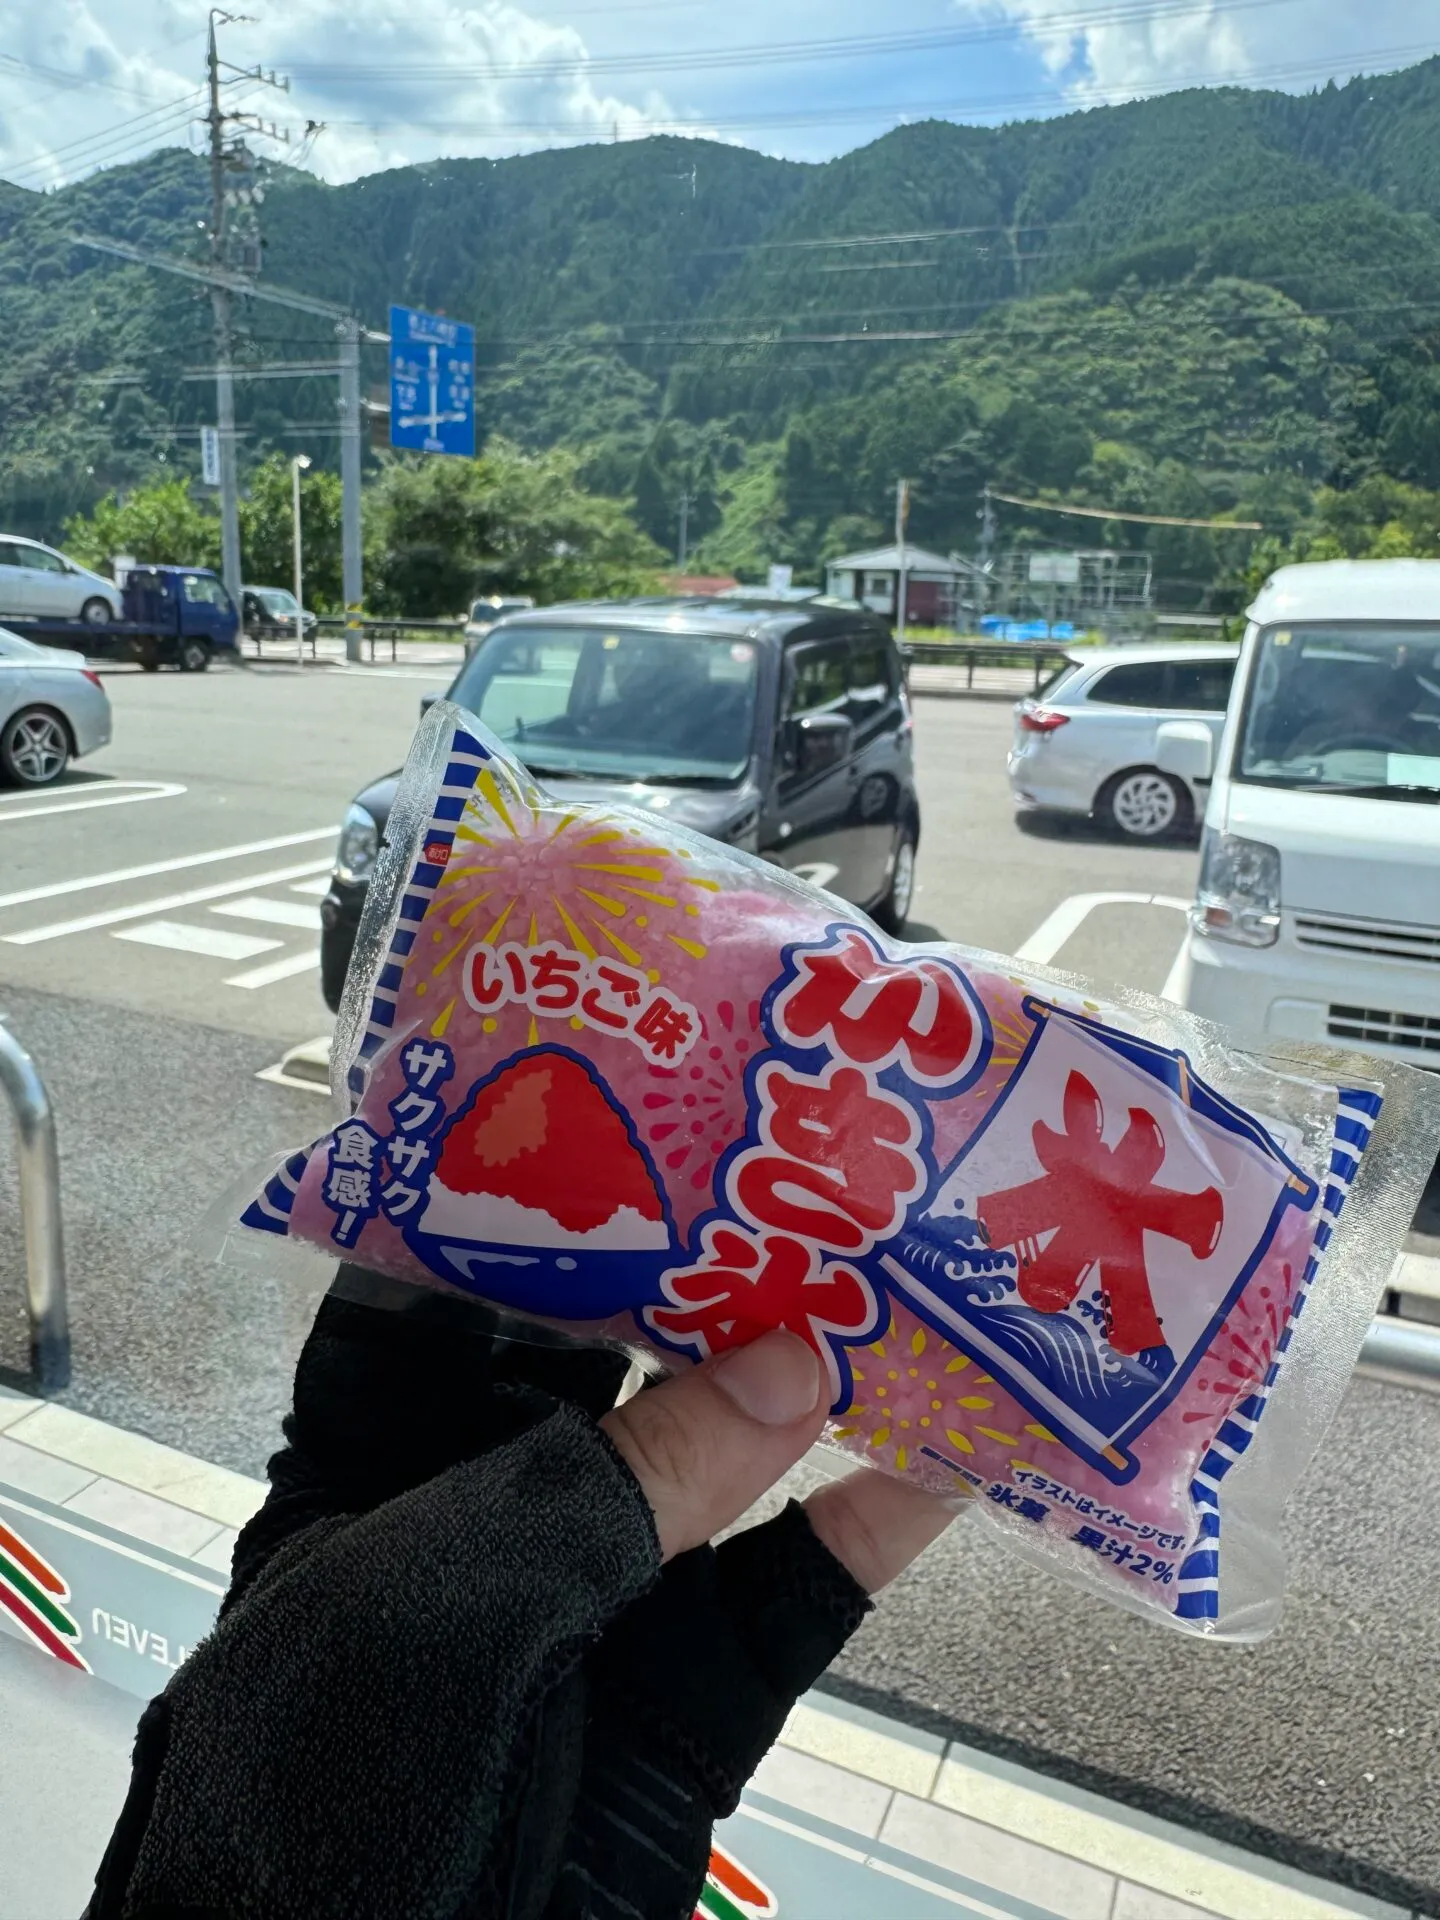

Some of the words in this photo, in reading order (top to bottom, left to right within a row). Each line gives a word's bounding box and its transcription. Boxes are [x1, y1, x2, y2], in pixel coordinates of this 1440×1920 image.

[469, 948, 695, 1062] いちご味
[381, 1043, 448, 1217] サクサク
[652, 932, 975, 1366] かき氷
